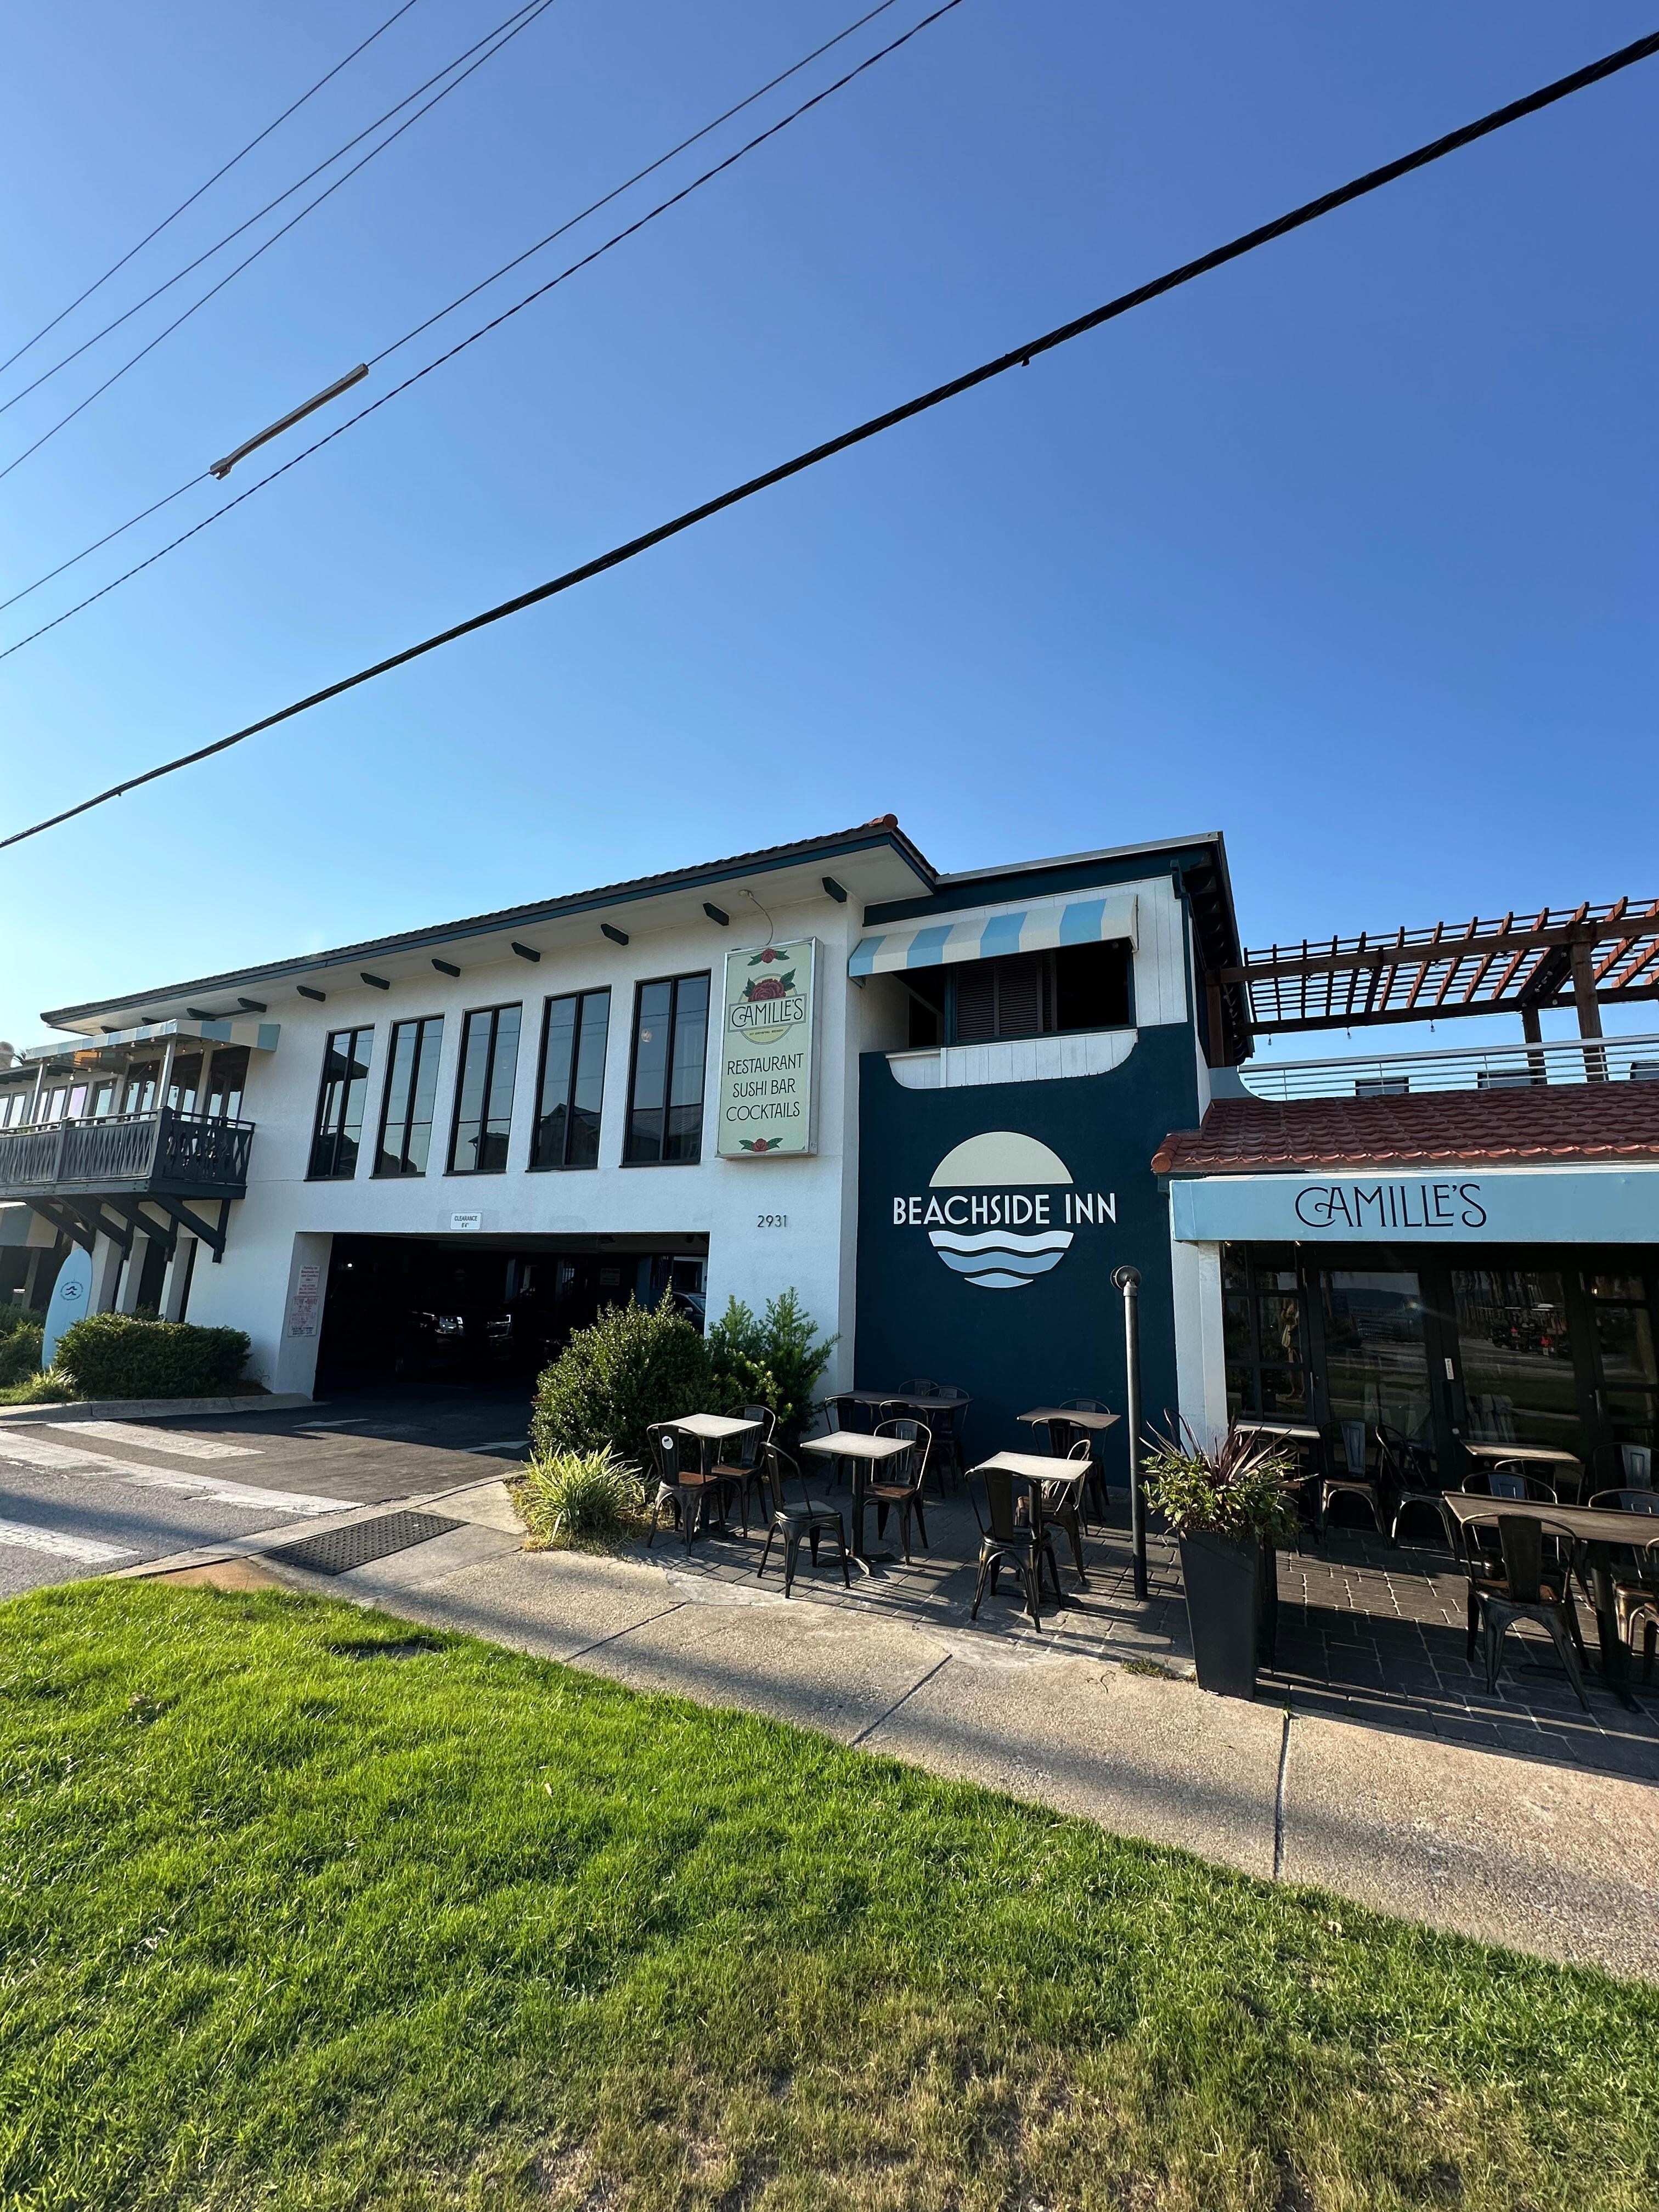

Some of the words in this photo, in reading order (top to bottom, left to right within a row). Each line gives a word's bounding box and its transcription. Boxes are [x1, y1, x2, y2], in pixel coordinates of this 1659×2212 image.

[731, 997, 803, 1028] CAMILLE'S
[727, 1053, 804, 1076] RESTAURANT
[732, 1080, 768, 1098] SUSHI
[770, 1077, 796, 1095] BAR
[726, 1101, 800, 1122] COCKTAILS
[893, 1194, 1050, 1225] BEACHSIDE
[1065, 1193, 1117, 1224] INN
[1295, 1183, 1487, 1228] CAMILLE'S
[757, 1215, 787, 1228] 2931
